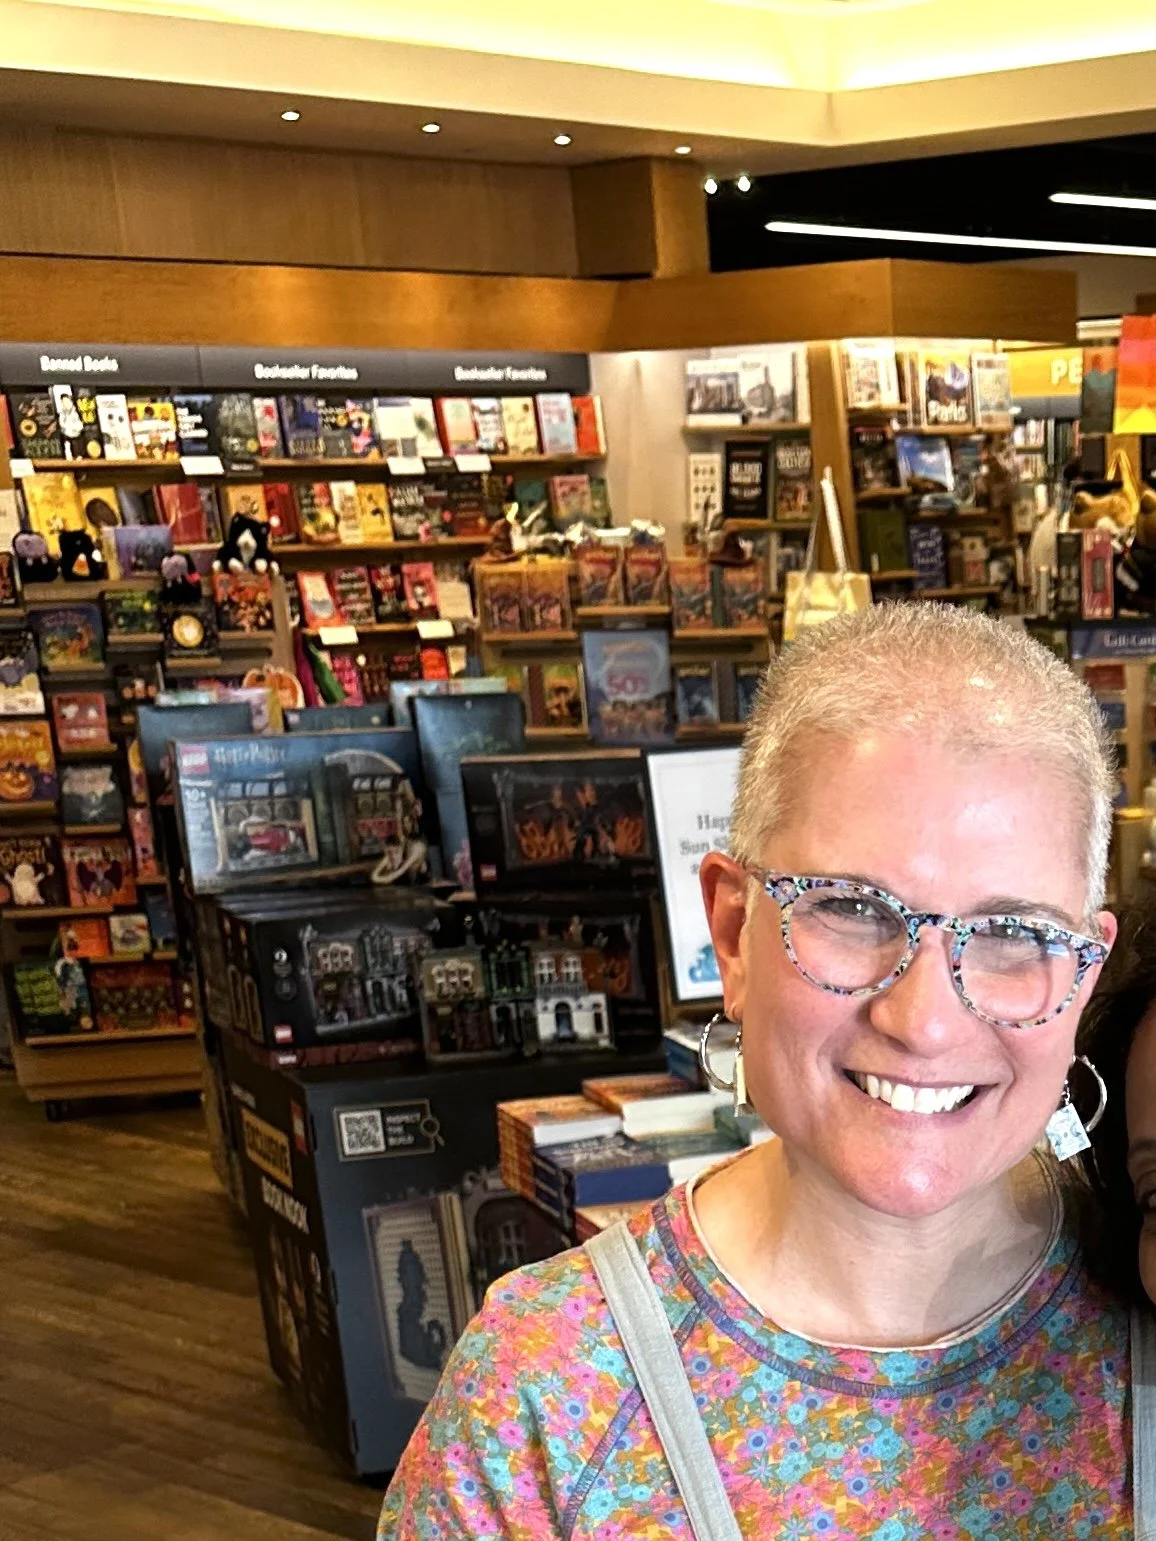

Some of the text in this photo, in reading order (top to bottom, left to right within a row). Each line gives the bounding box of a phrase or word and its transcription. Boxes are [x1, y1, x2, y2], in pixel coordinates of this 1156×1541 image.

[84, 356, 119, 372] Books
[254, 364, 358, 380] Bookseller Favorites
